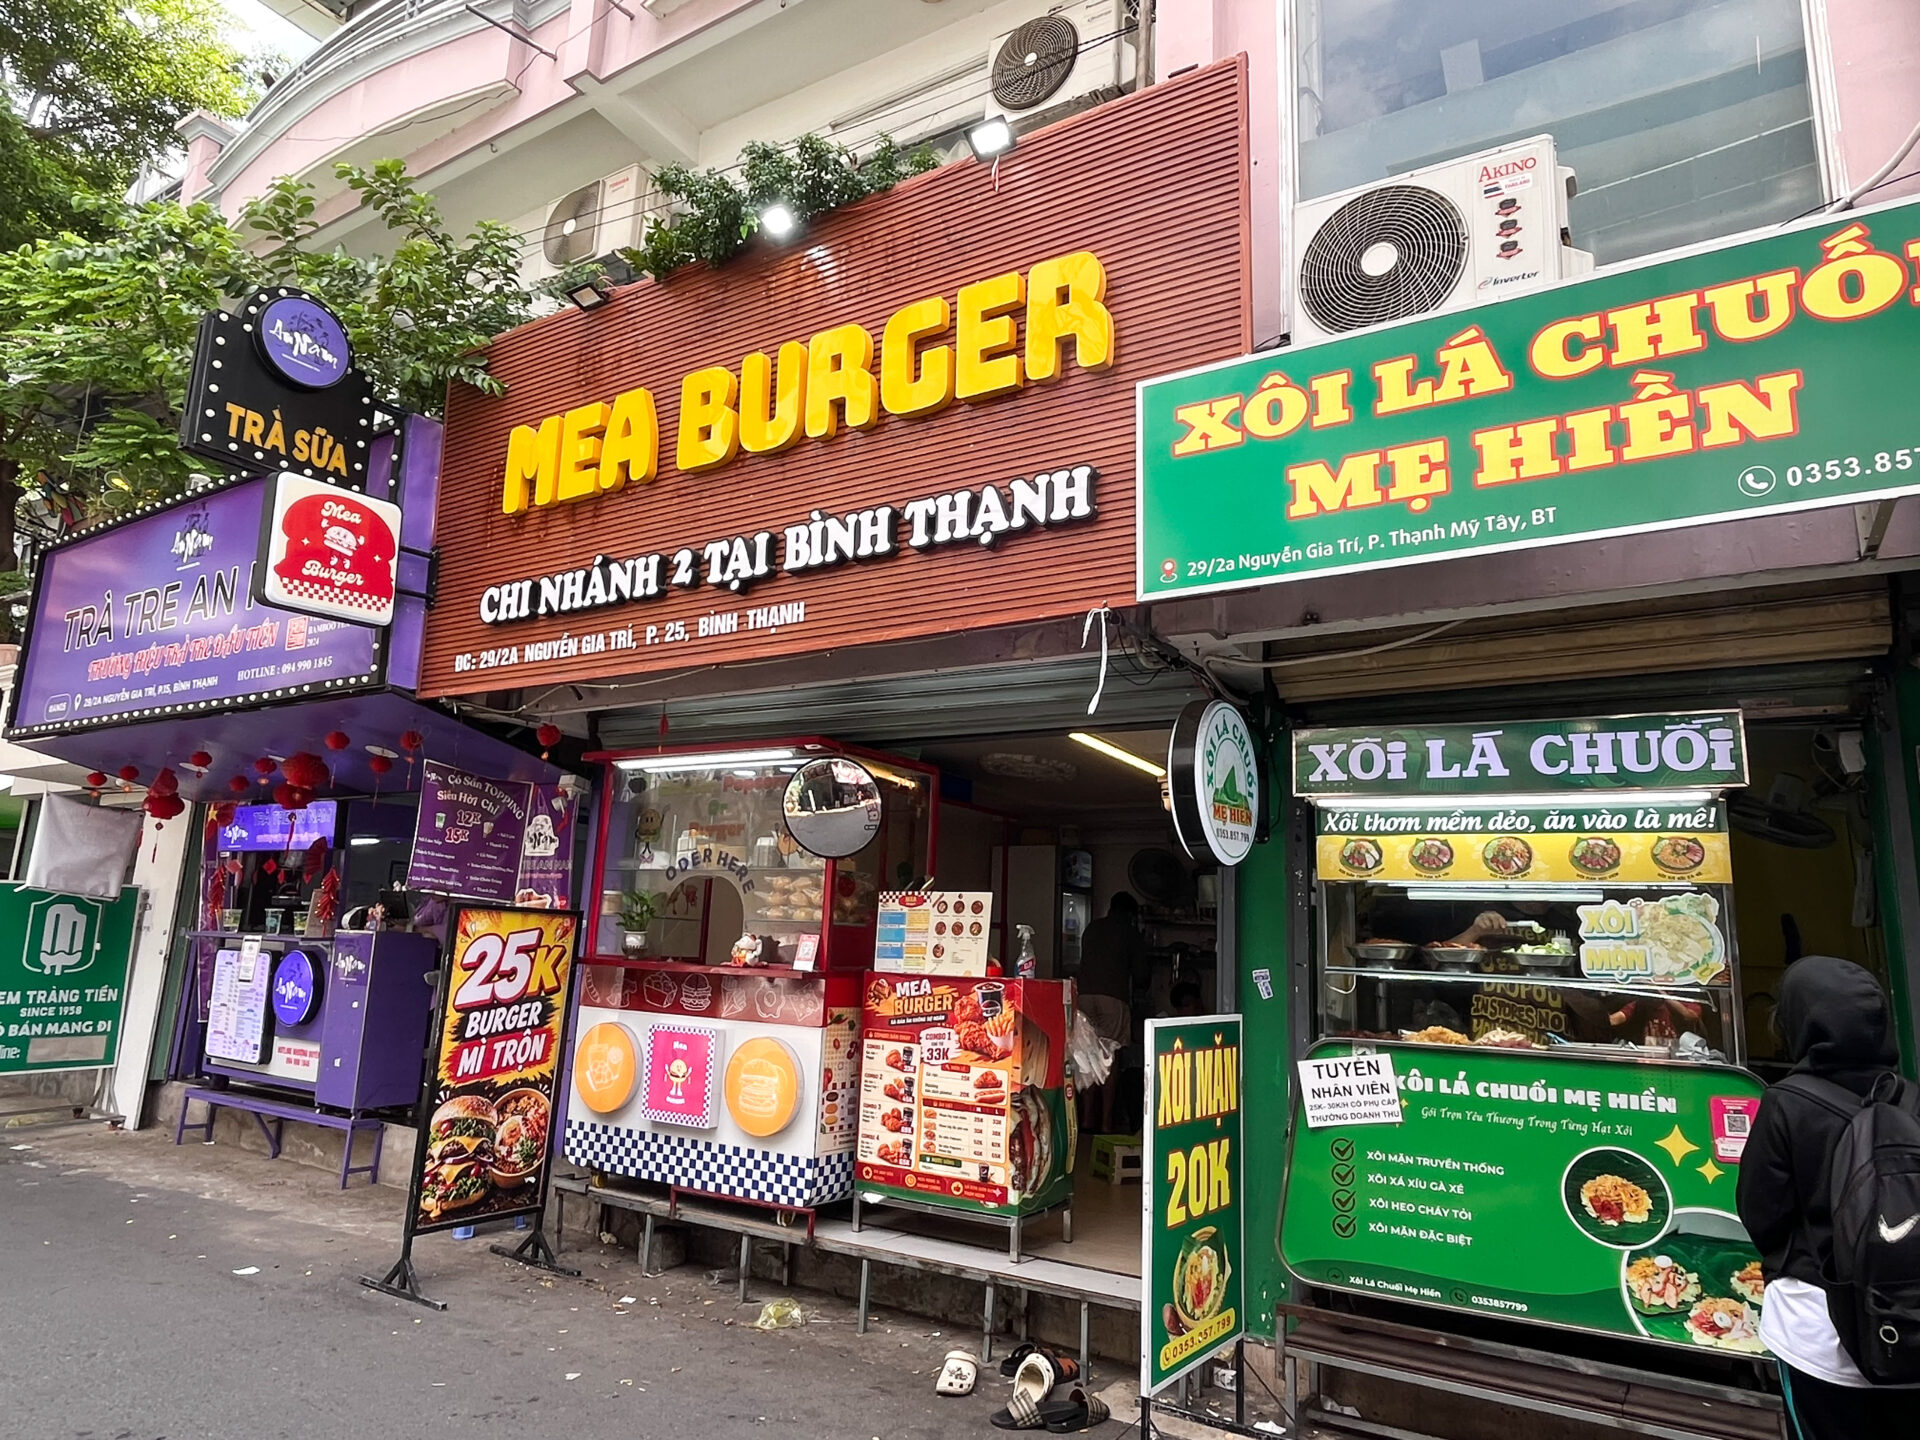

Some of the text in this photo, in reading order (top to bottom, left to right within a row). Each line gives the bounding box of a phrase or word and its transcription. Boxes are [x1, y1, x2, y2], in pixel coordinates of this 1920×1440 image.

[1478, 157, 1537, 183] AKINO
[502, 250, 1115, 516] MEA BURGER
[1173, 370, 1353, 457] XÔI
[1373, 326, 1512, 417] LÁ
[225, 402, 348, 477] TRÀ SỮA
[1285, 369, 1801, 519] MẸ HIỀN
[320, 500, 362, 525] Mea
[480, 465, 1094, 624] CHI NHÁNH 2 TẠI BÌNH THẠNH
[1186, 506, 1558, 577] 29/2a Nguyễn Gia Trí, P. Thạnh Mỹ Tây, BT
[301, 559, 364, 587] Burger
[63, 589, 113, 653] TRÀ
[124, 580, 182, 639] TRE
[184, 565, 239, 625] AN
[479, 648, 519, 668] 29/2A
[524, 632, 578, 663] NGUYỄN
[581, 633, 606, 653] GIA
[608, 623, 638, 650] TRÍ,
[645, 625, 660, 645] P.
[664, 620, 690, 643] 25,
[697, 610, 738, 637] BÌNH
[746, 601, 805, 634] THẠNH
[237, 655, 333, 682] HOTLINE 094 990 1845
[192, 676, 218, 693] THẠNH
[484, 782, 525, 821] TOPPING
[1213, 802, 1228, 826] MẸ
[1323, 806, 1717, 833] Xôi thơm mềm dẻo, ăn vào là mê!
[445, 826, 470, 844] 15K
[665, 847, 756, 895] ODER HERE
[1582, 904, 1636, 936] XÔI
[453, 927, 566, 1012] 25K
[1585, 944, 1649, 979] MẶN
[26, 985, 80, 1004] TRÀNG
[895, 978, 932, 998] MEA
[20, 1005, 83, 1018] SINCE 1958
[893, 992, 954, 1016] BURGER
[8, 1020, 112, 1037] BÁN MANG ĐI
[464, 1001, 543, 1039] BURGER
[925, 1032, 946, 1041] COMBO
[456, 1029, 547, 1077] MÌ TRỘN
[926, 1047, 950, 1061] 33K
[1159, 1033, 1238, 1128] XÔI MẶN
[1311, 1080, 1391, 1100] NHÂN VIÊN
[1439, 1070, 1470, 1096] LÁ
[1475, 1079, 1558, 1104] CHUỐI
[1563, 1088, 1601, 1113] MẸ
[1608, 1086, 1678, 1115] HIỀN
[1350, 1110, 1381, 1121] DOANH
[1382, 1109, 1400, 1119] THU
[1421, 1106, 1437, 1119] Gói
[1465, 1110, 1483, 1122] Yêu
[1527, 1115, 1557, 1134] Trong
[1592, 1121, 1611, 1135] Hạt
[1366, 1150, 1386, 1161] XÔI
[1388, 1152, 1414, 1165] MẶN
[1166, 1137, 1232, 1229] 20K
[1367, 1173, 1465, 1195] XÔI XÁ XÍU GÀ XÉ
[1369, 1197, 1389, 1209] XÔI
[1391, 1202, 1416, 1213] HEO
[1418, 1204, 1450, 1218] CHÁY
[1368, 1222, 1473, 1247] XÔI MẶN ĐẶC BIỆT
[1349, 1275, 1364, 1285] Xôi
[1364, 1277, 1376, 1287] Lá
[1404, 1283, 1419, 1296] Mẹ
[1471, 1295, 1529, 1312] 0353857799
